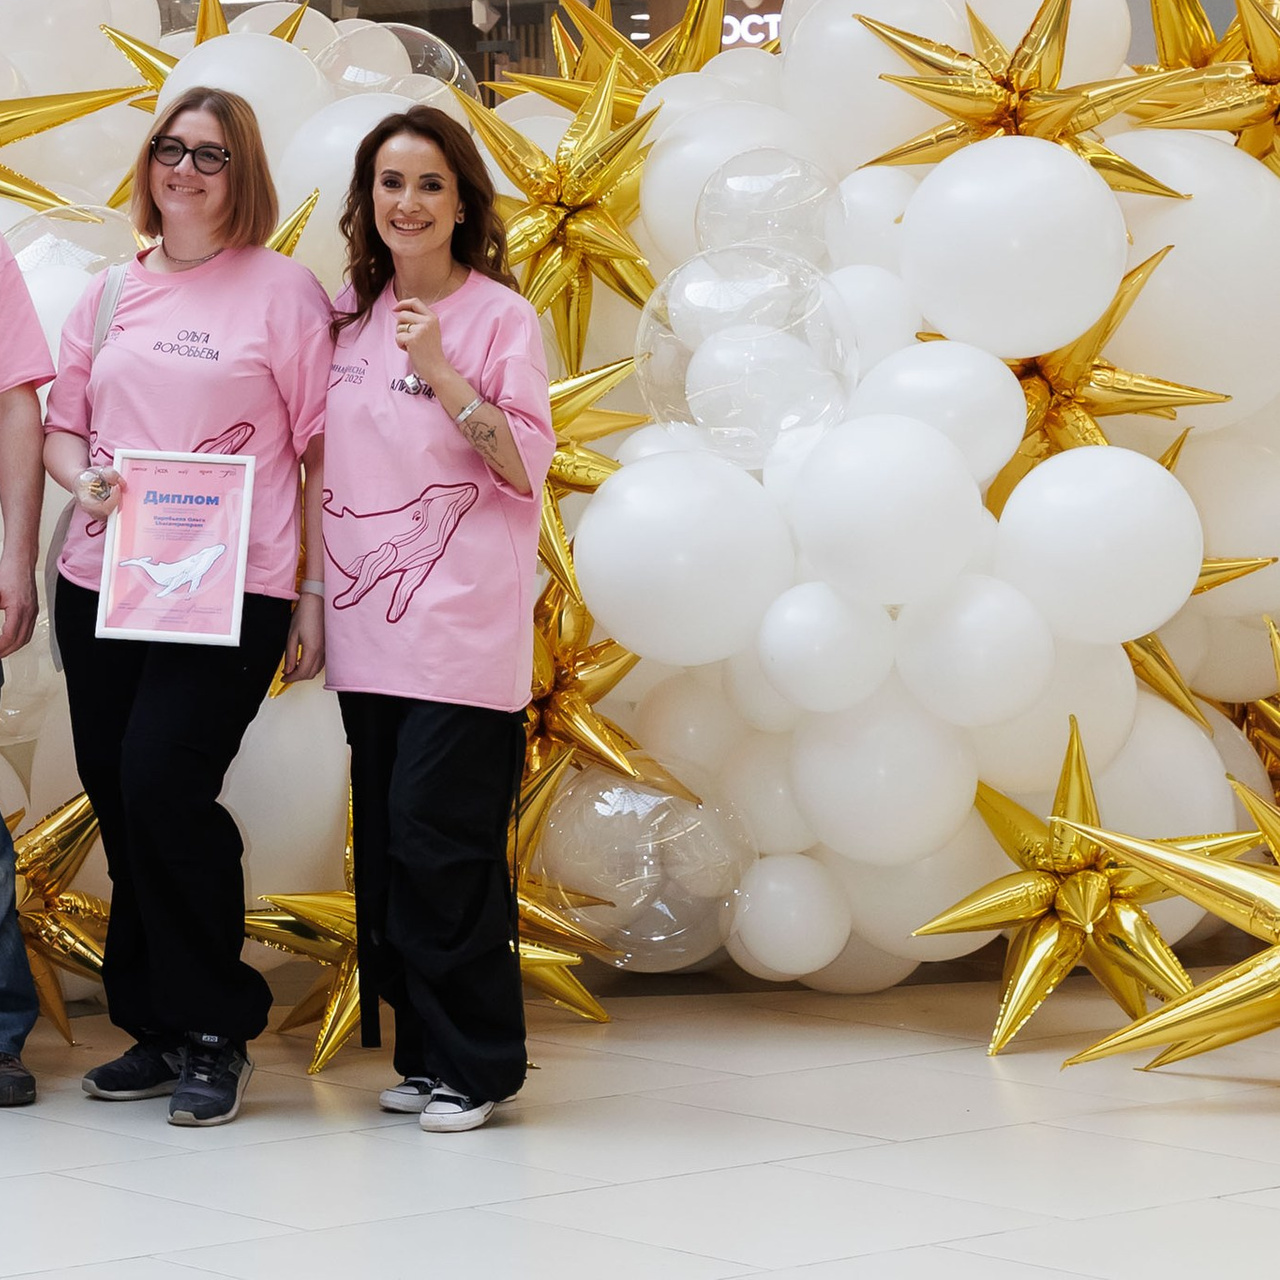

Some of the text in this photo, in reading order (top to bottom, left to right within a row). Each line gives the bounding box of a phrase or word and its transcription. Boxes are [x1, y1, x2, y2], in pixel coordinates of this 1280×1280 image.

[177, 329, 210, 344] ОЛЬГА
[152, 341, 220, 361] ВОРОБЬЕВА
[344, 373, 364, 385] 2025
[143, 490, 220, 506] Диплом
